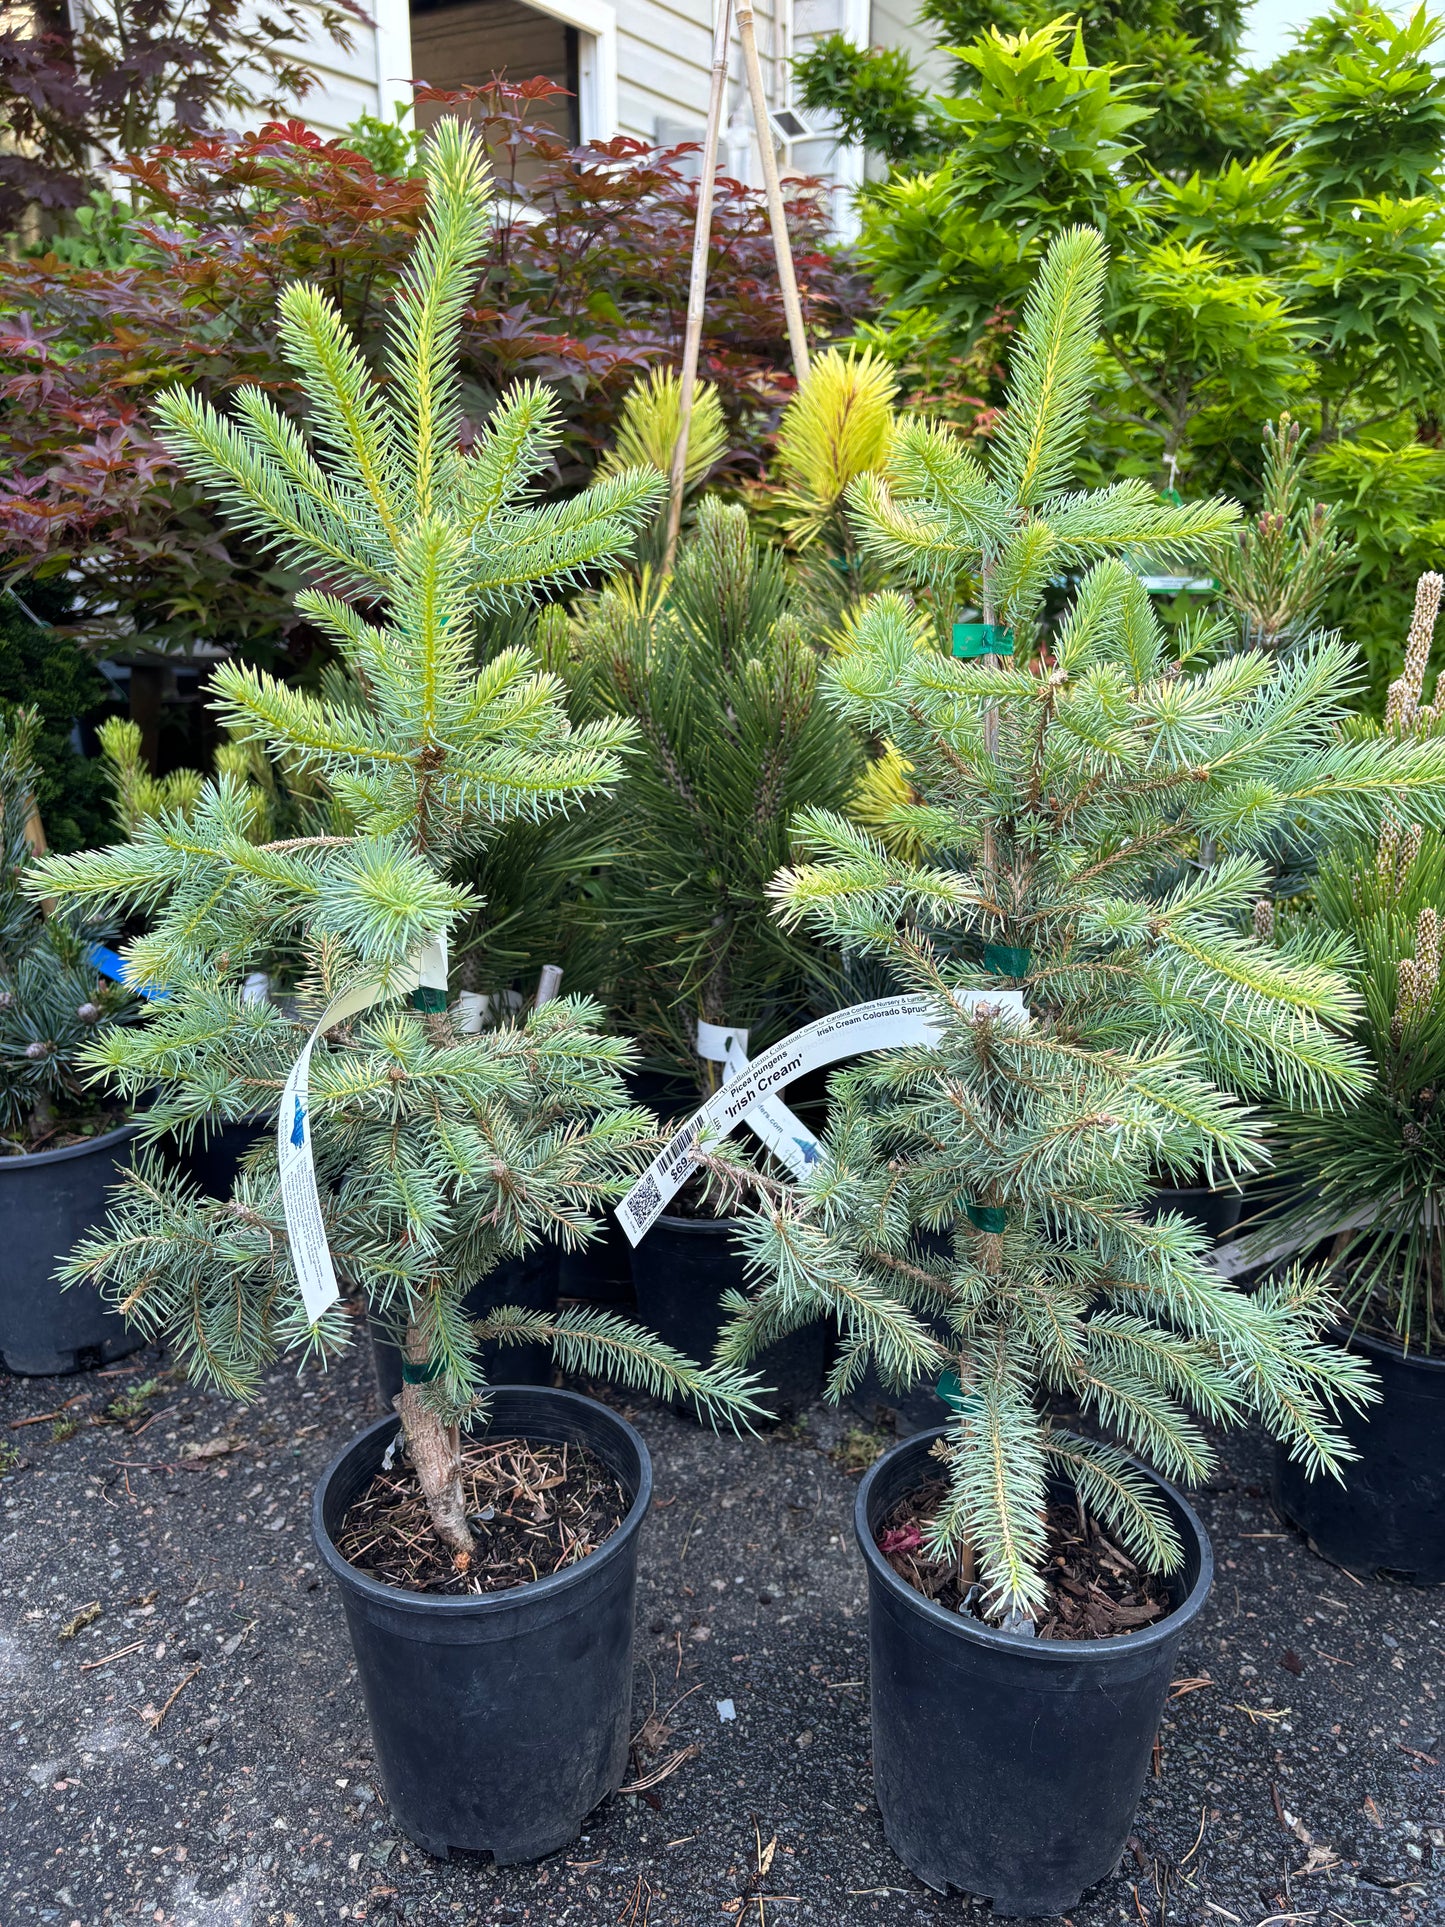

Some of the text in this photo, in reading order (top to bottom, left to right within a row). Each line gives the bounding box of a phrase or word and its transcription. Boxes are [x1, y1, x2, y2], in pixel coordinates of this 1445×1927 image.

[817, 1025, 835, 1037] Irish
[835, 1016, 862, 1029] Cream
[862, 1007, 900, 1021] Colorado
[826, 1011, 851, 1023] Carolina
[851, 1004, 876, 1014] Conifers
[876, 998, 900, 1008] Nursery
[725, 1053, 802, 1118] 'Irish Cream'
[730, 1077, 752, 1097] Picea
[753, 1051, 788, 1080] pungens
[670, 1157, 691, 1180] $69.
